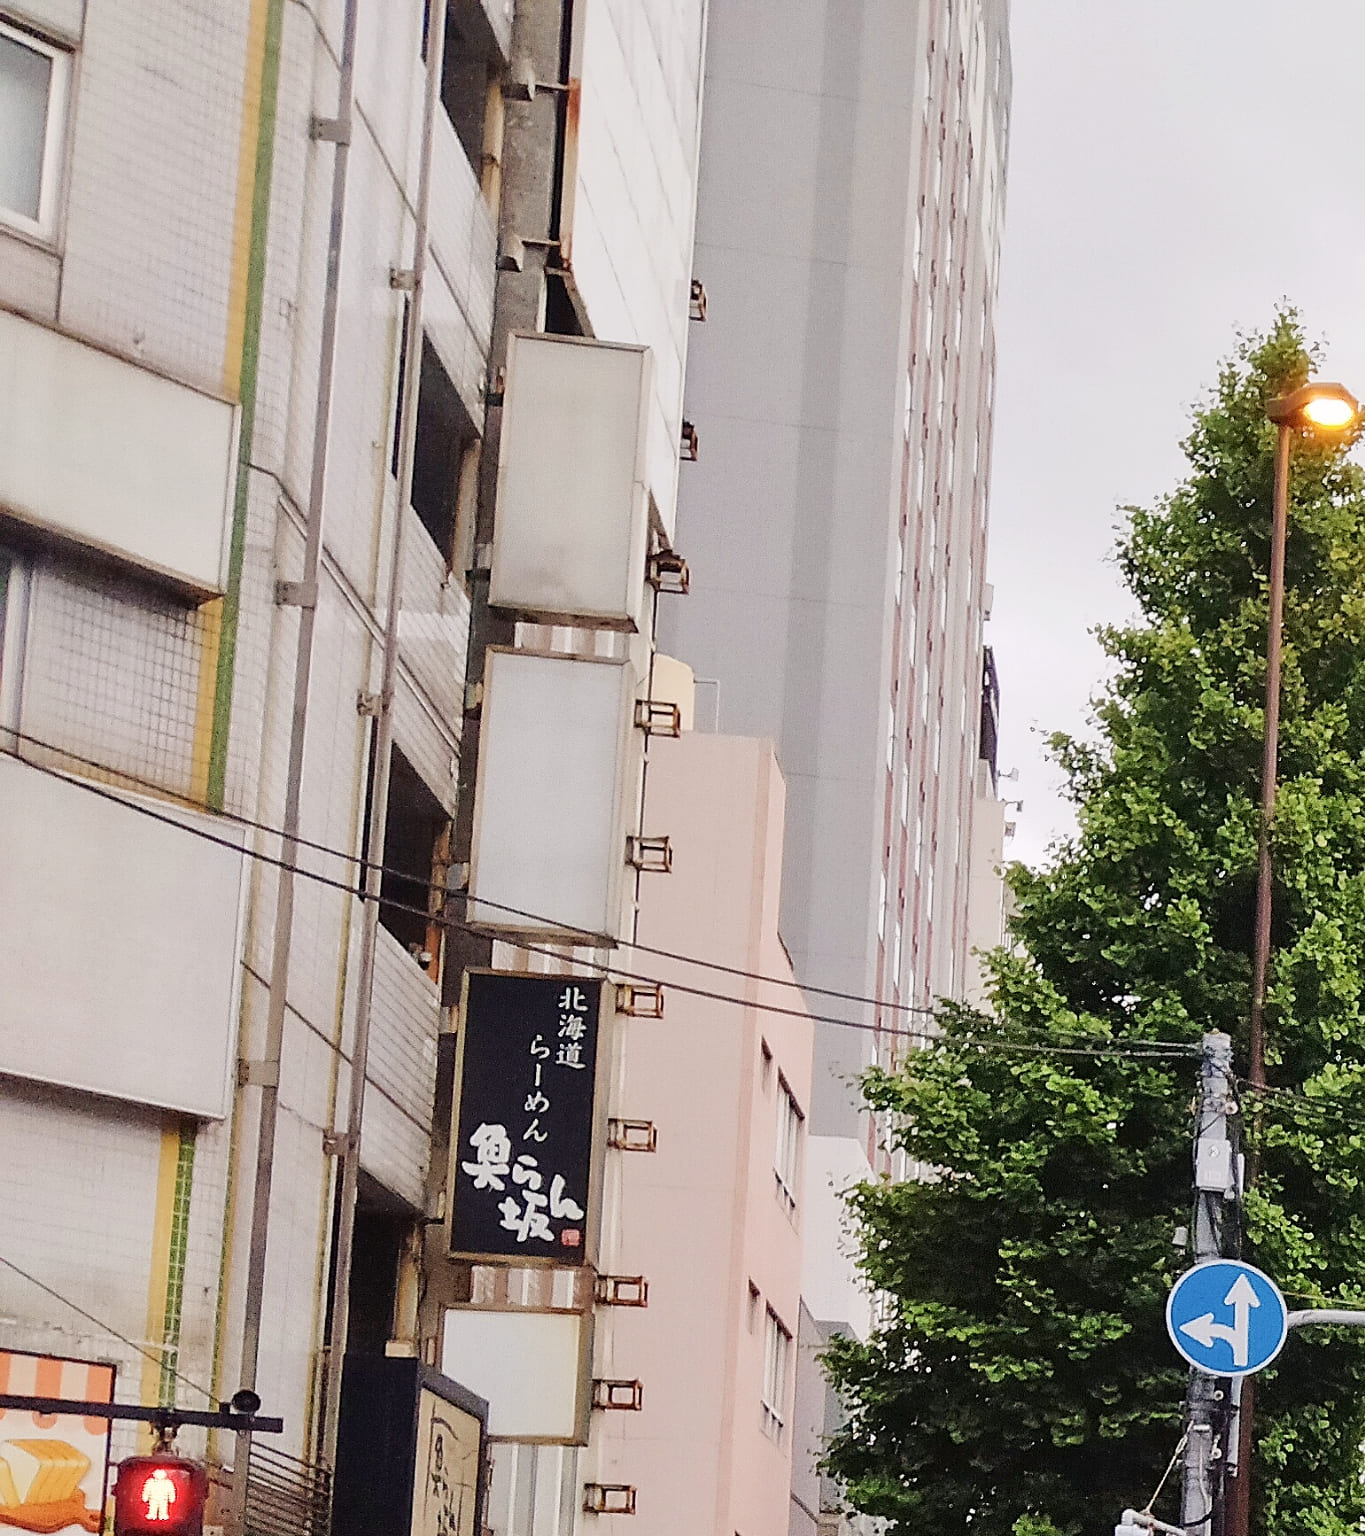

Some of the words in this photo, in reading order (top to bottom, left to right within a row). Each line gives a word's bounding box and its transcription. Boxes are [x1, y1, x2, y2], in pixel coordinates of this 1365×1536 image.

[555, 987, 589, 1069] 北海道
[523, 1034, 550, 1142] らーめん
